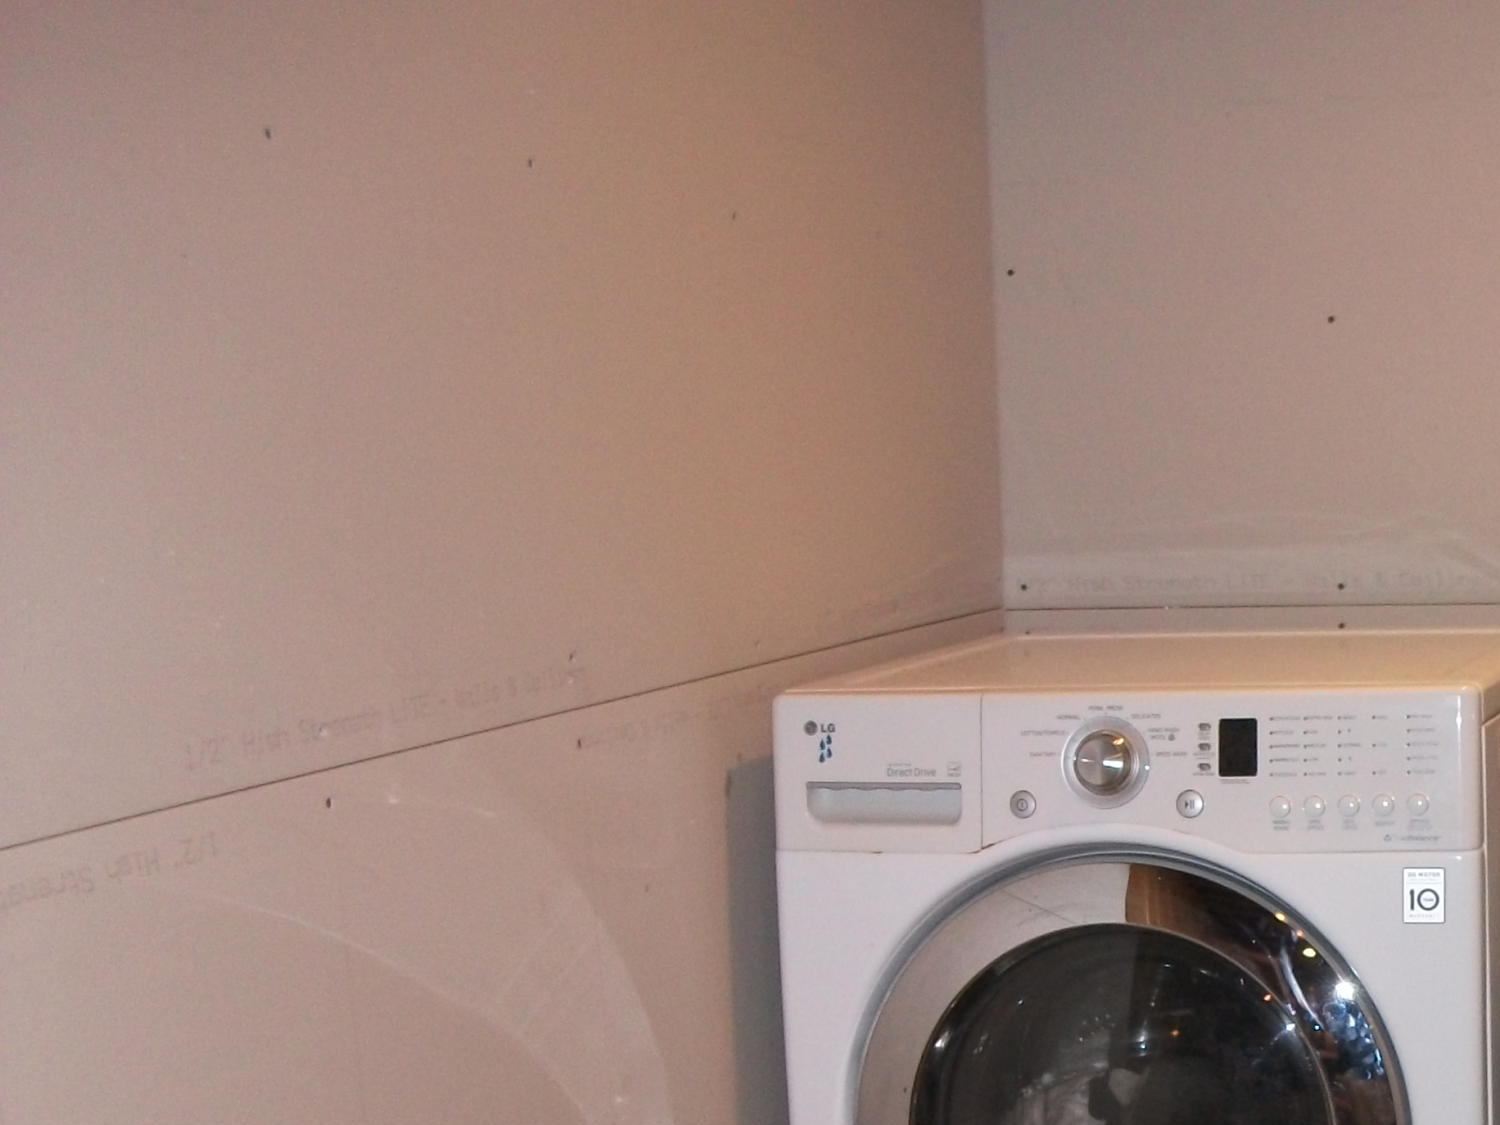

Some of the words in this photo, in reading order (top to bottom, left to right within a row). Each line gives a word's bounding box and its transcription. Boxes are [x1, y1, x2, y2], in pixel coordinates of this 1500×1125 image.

[820, 723, 836, 733] LG
[887, 767, 912, 777] Direct
[914, 767, 937, 777] Drive
[1409, 888, 1440, 911] 10
